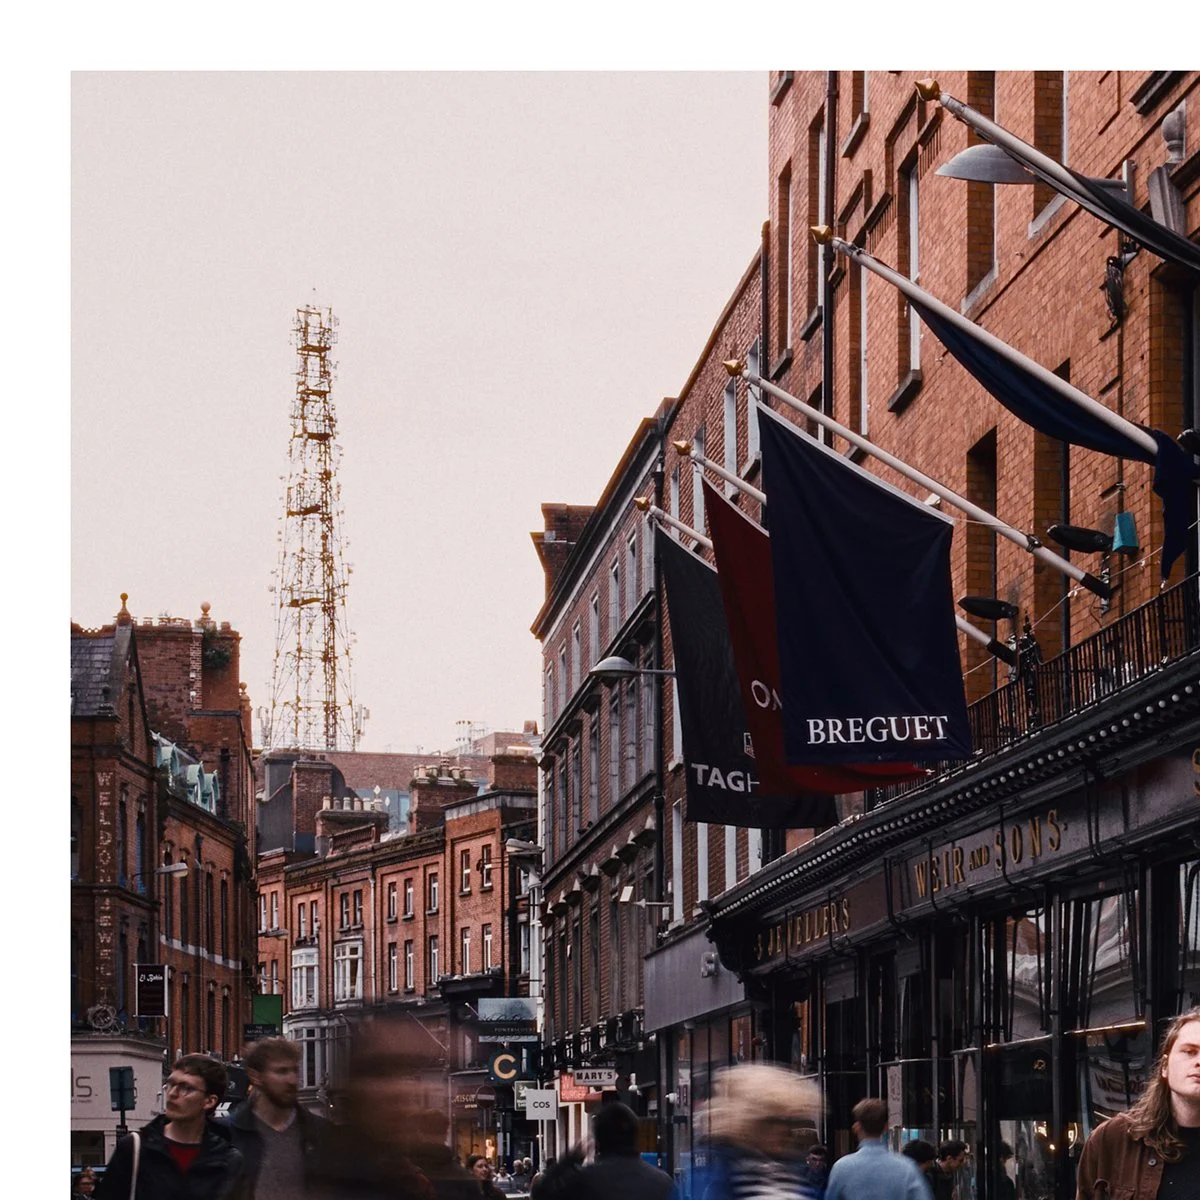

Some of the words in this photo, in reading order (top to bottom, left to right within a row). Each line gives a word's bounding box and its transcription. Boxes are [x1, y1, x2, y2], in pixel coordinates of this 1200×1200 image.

[806, 714, 949, 746] BREGUET
[914, 847, 965, 898] WEIR
[968, 844, 990, 871] AND
[576, 1071, 613, 1080] MARY'S
[532, 1101, 550, 1109] COS
